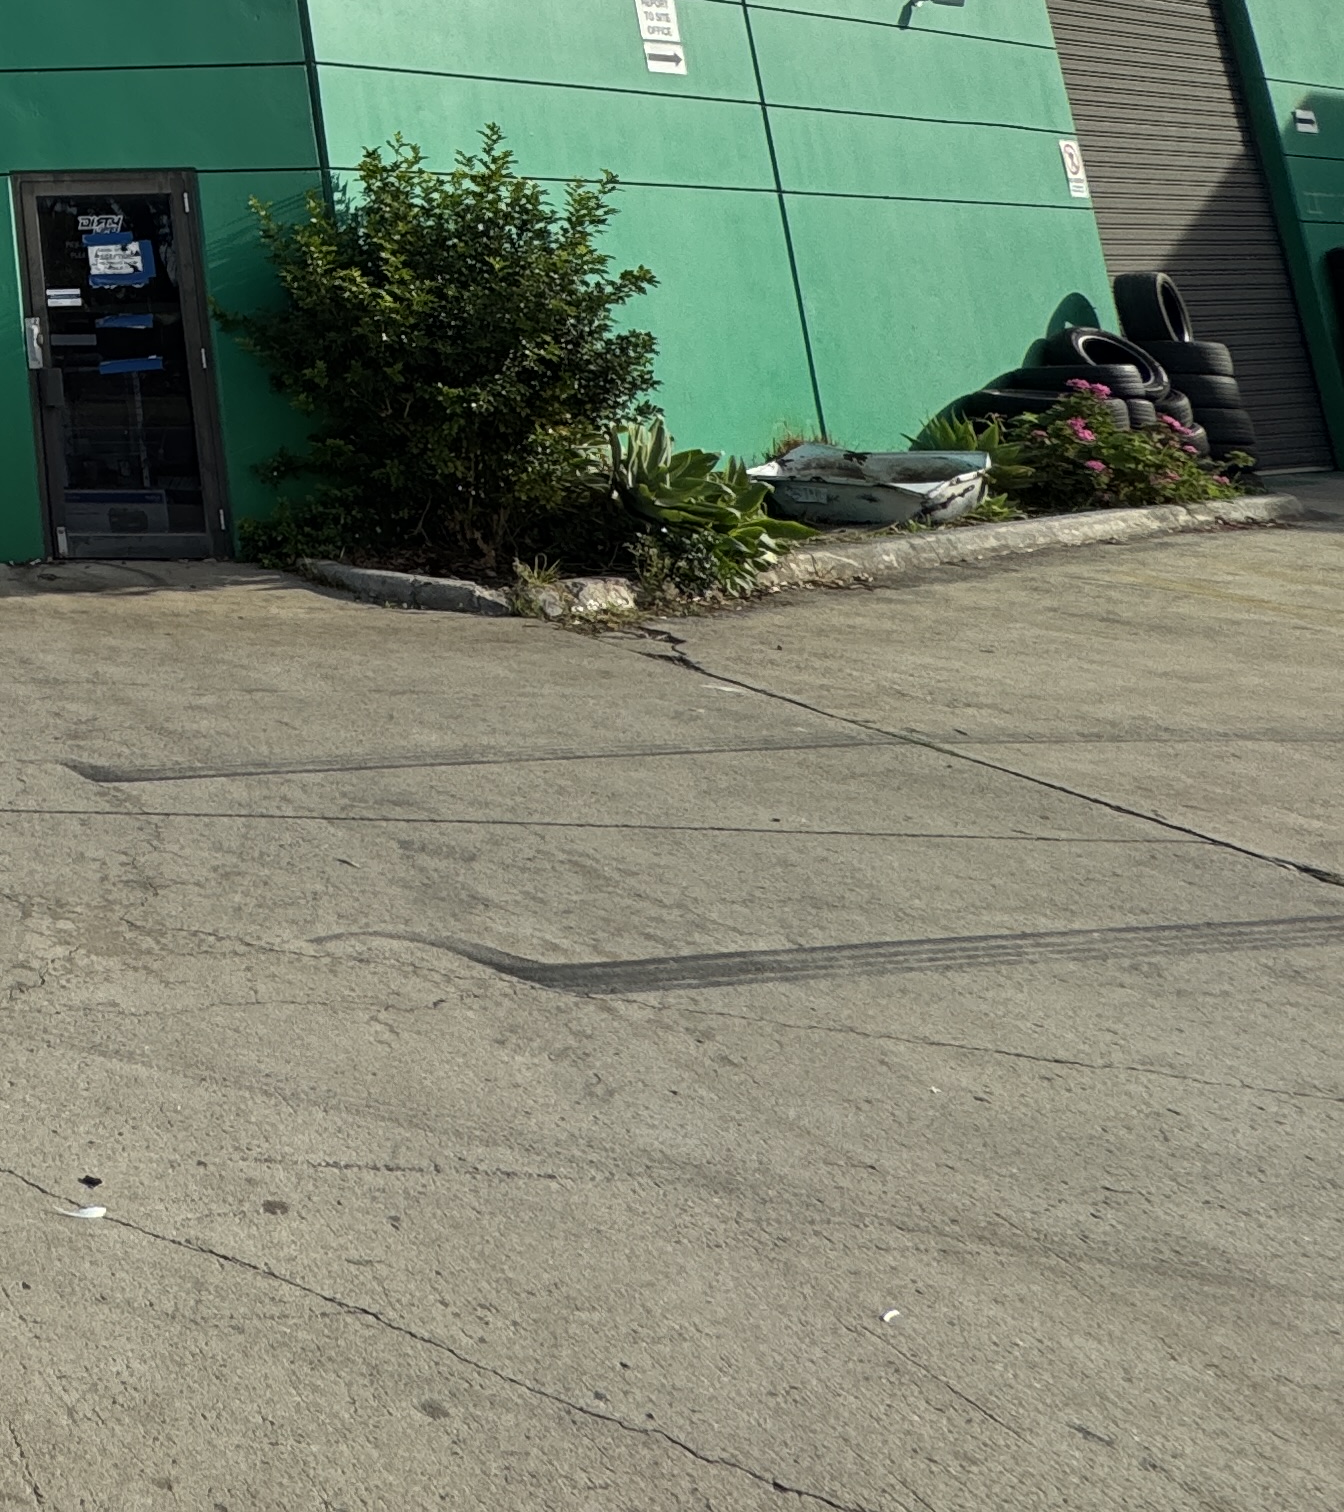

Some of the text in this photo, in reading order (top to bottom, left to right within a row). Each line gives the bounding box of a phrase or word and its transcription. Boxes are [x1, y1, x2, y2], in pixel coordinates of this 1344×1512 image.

[644, 11, 671, 23] TO SITE
[647, 25, 672, 36] OFFICE
